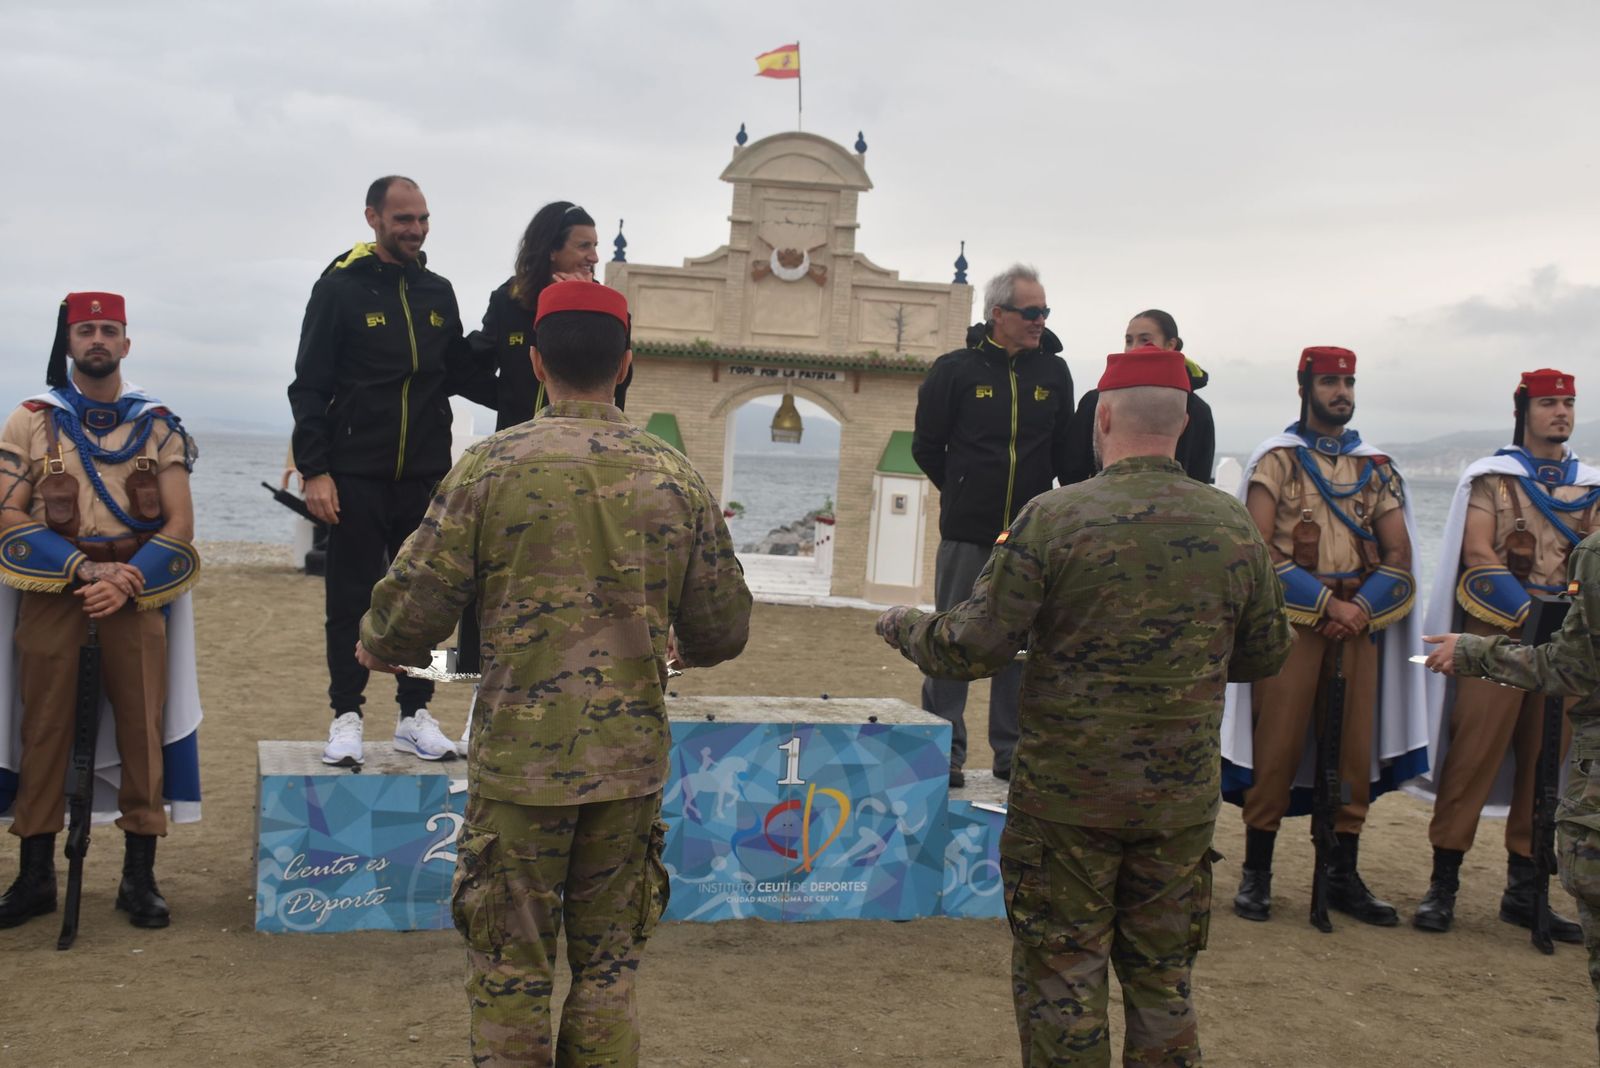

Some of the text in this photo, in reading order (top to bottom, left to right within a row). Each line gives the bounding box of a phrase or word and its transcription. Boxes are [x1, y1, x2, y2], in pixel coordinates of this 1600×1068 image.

[367, 316, 386, 327] 54
[509, 335, 524, 346] 54
[729, 366, 755, 375] TODO
[782, 369, 796, 378] LA
[799, 370, 836, 380] PATRIA
[975, 389, 993, 399] 54
[777, 737, 806, 785] 1
[422, 811, 465, 864] 2
[365, 857, 392, 872] es
[699, 880, 868, 894] INSTITUTO CEUTÍ DE DEPORTES
[287, 886, 392, 924] Deporte
[726, 895, 756, 903] CIUDAD
[803, 895, 814, 903] DE
[816, 895, 840, 903] CEUTA
